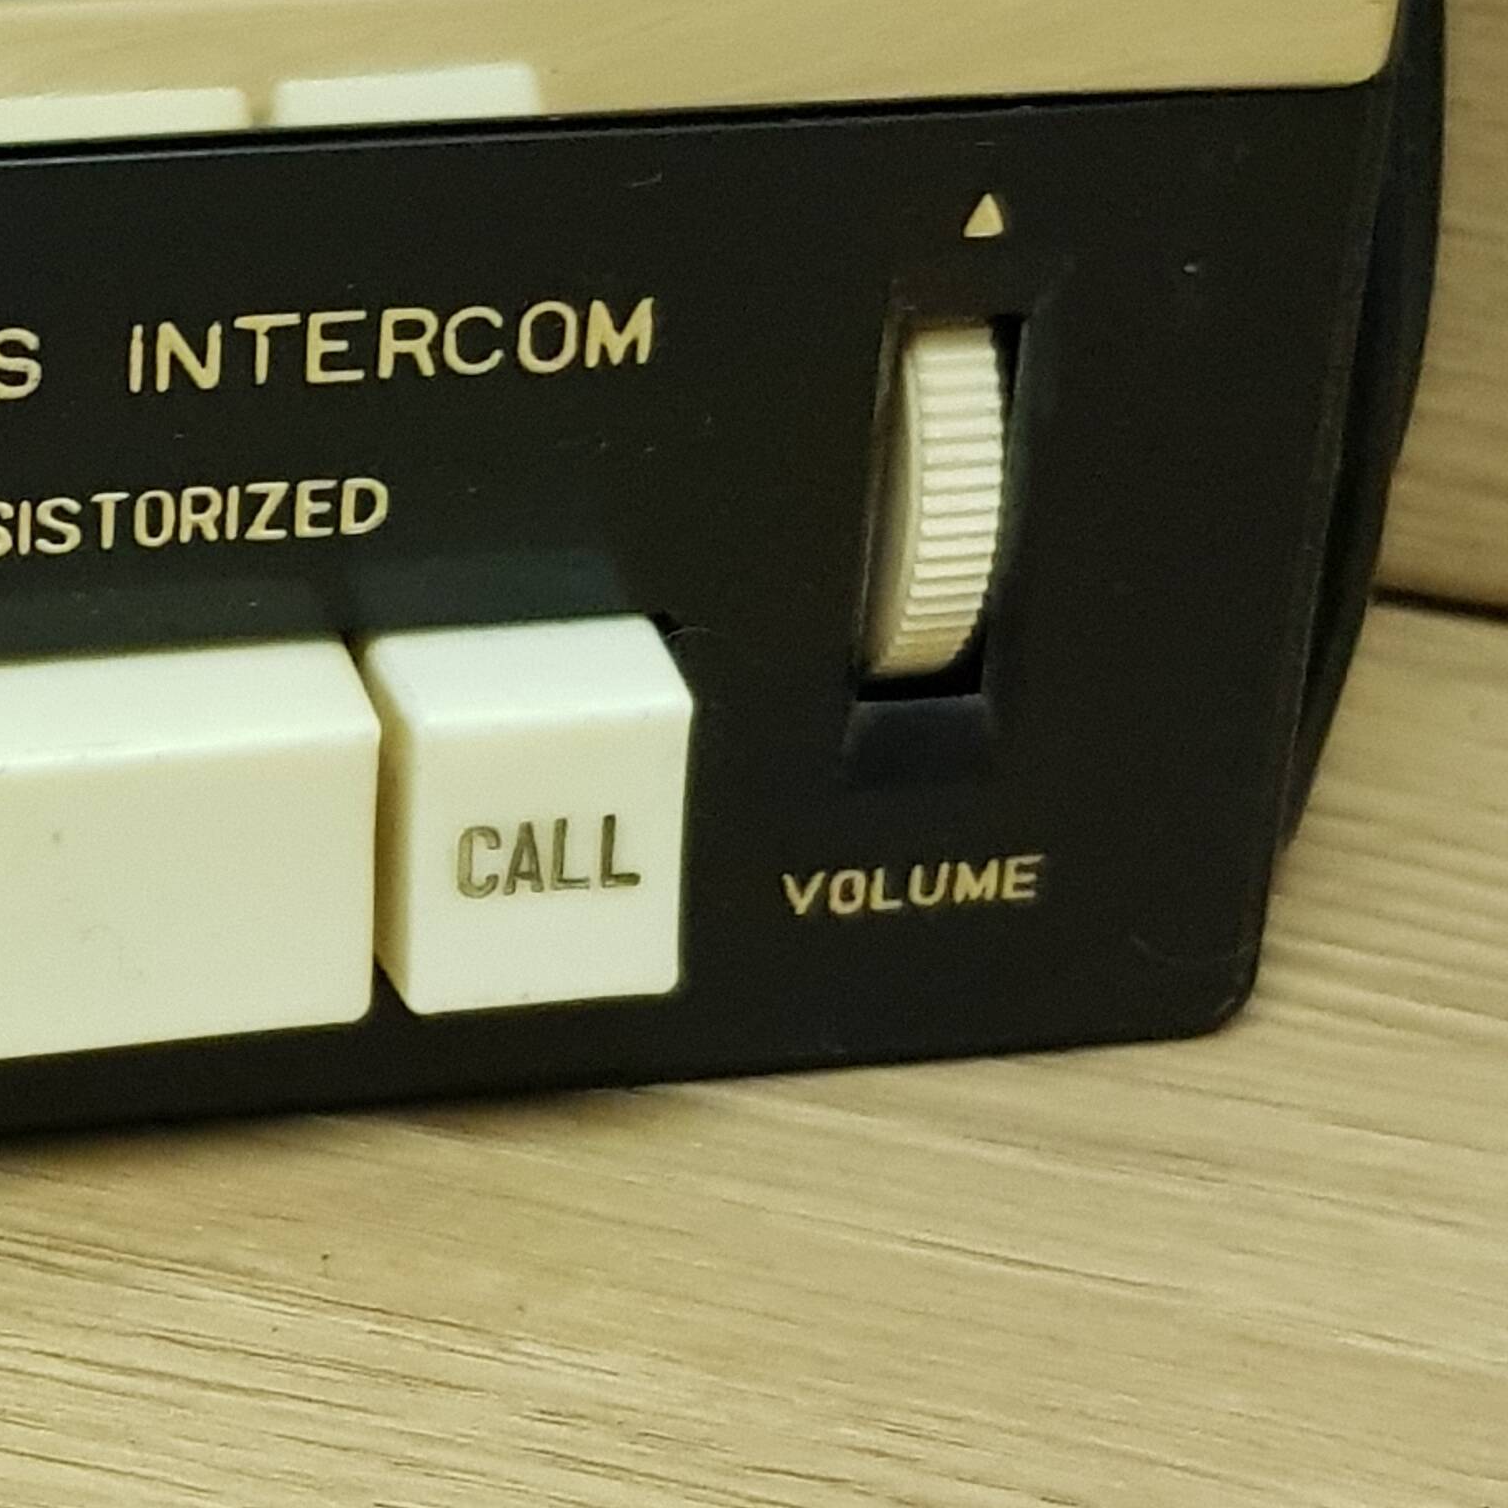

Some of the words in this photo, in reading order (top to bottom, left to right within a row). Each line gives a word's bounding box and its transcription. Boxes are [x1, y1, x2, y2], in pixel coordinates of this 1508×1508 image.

[129, 297, 656, 393] INTERCOM
[456, 813, 642, 899] CALL
[782, 854, 1043, 915] VOLUME
